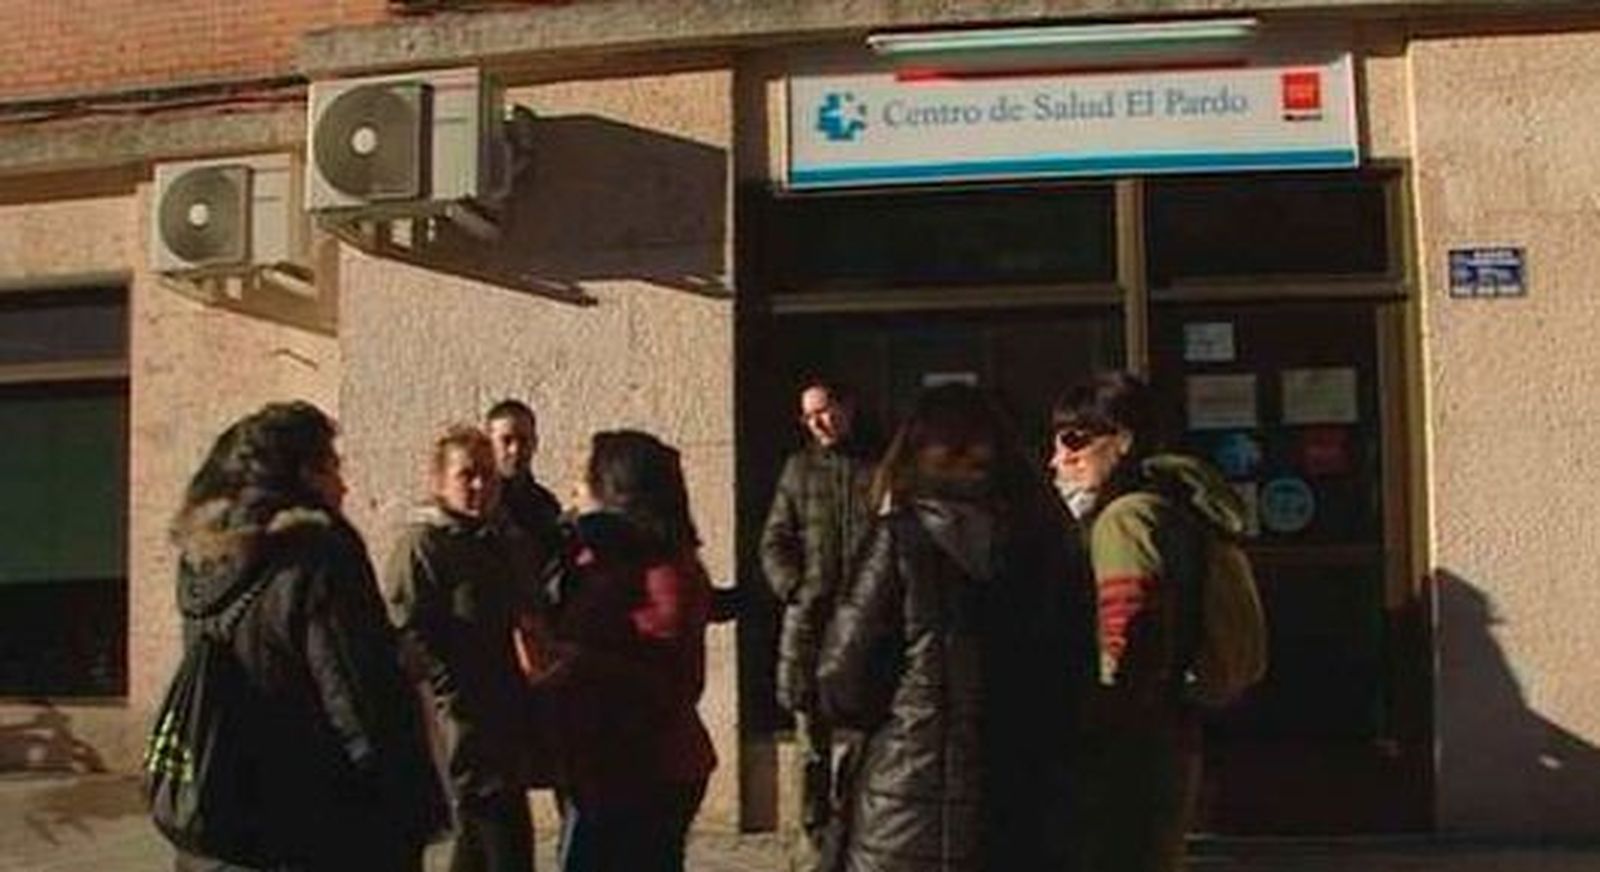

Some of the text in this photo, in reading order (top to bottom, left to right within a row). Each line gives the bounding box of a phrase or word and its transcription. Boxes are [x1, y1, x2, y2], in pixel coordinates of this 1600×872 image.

[882, 85, 1249, 127] Centro de Salud El Pardo
